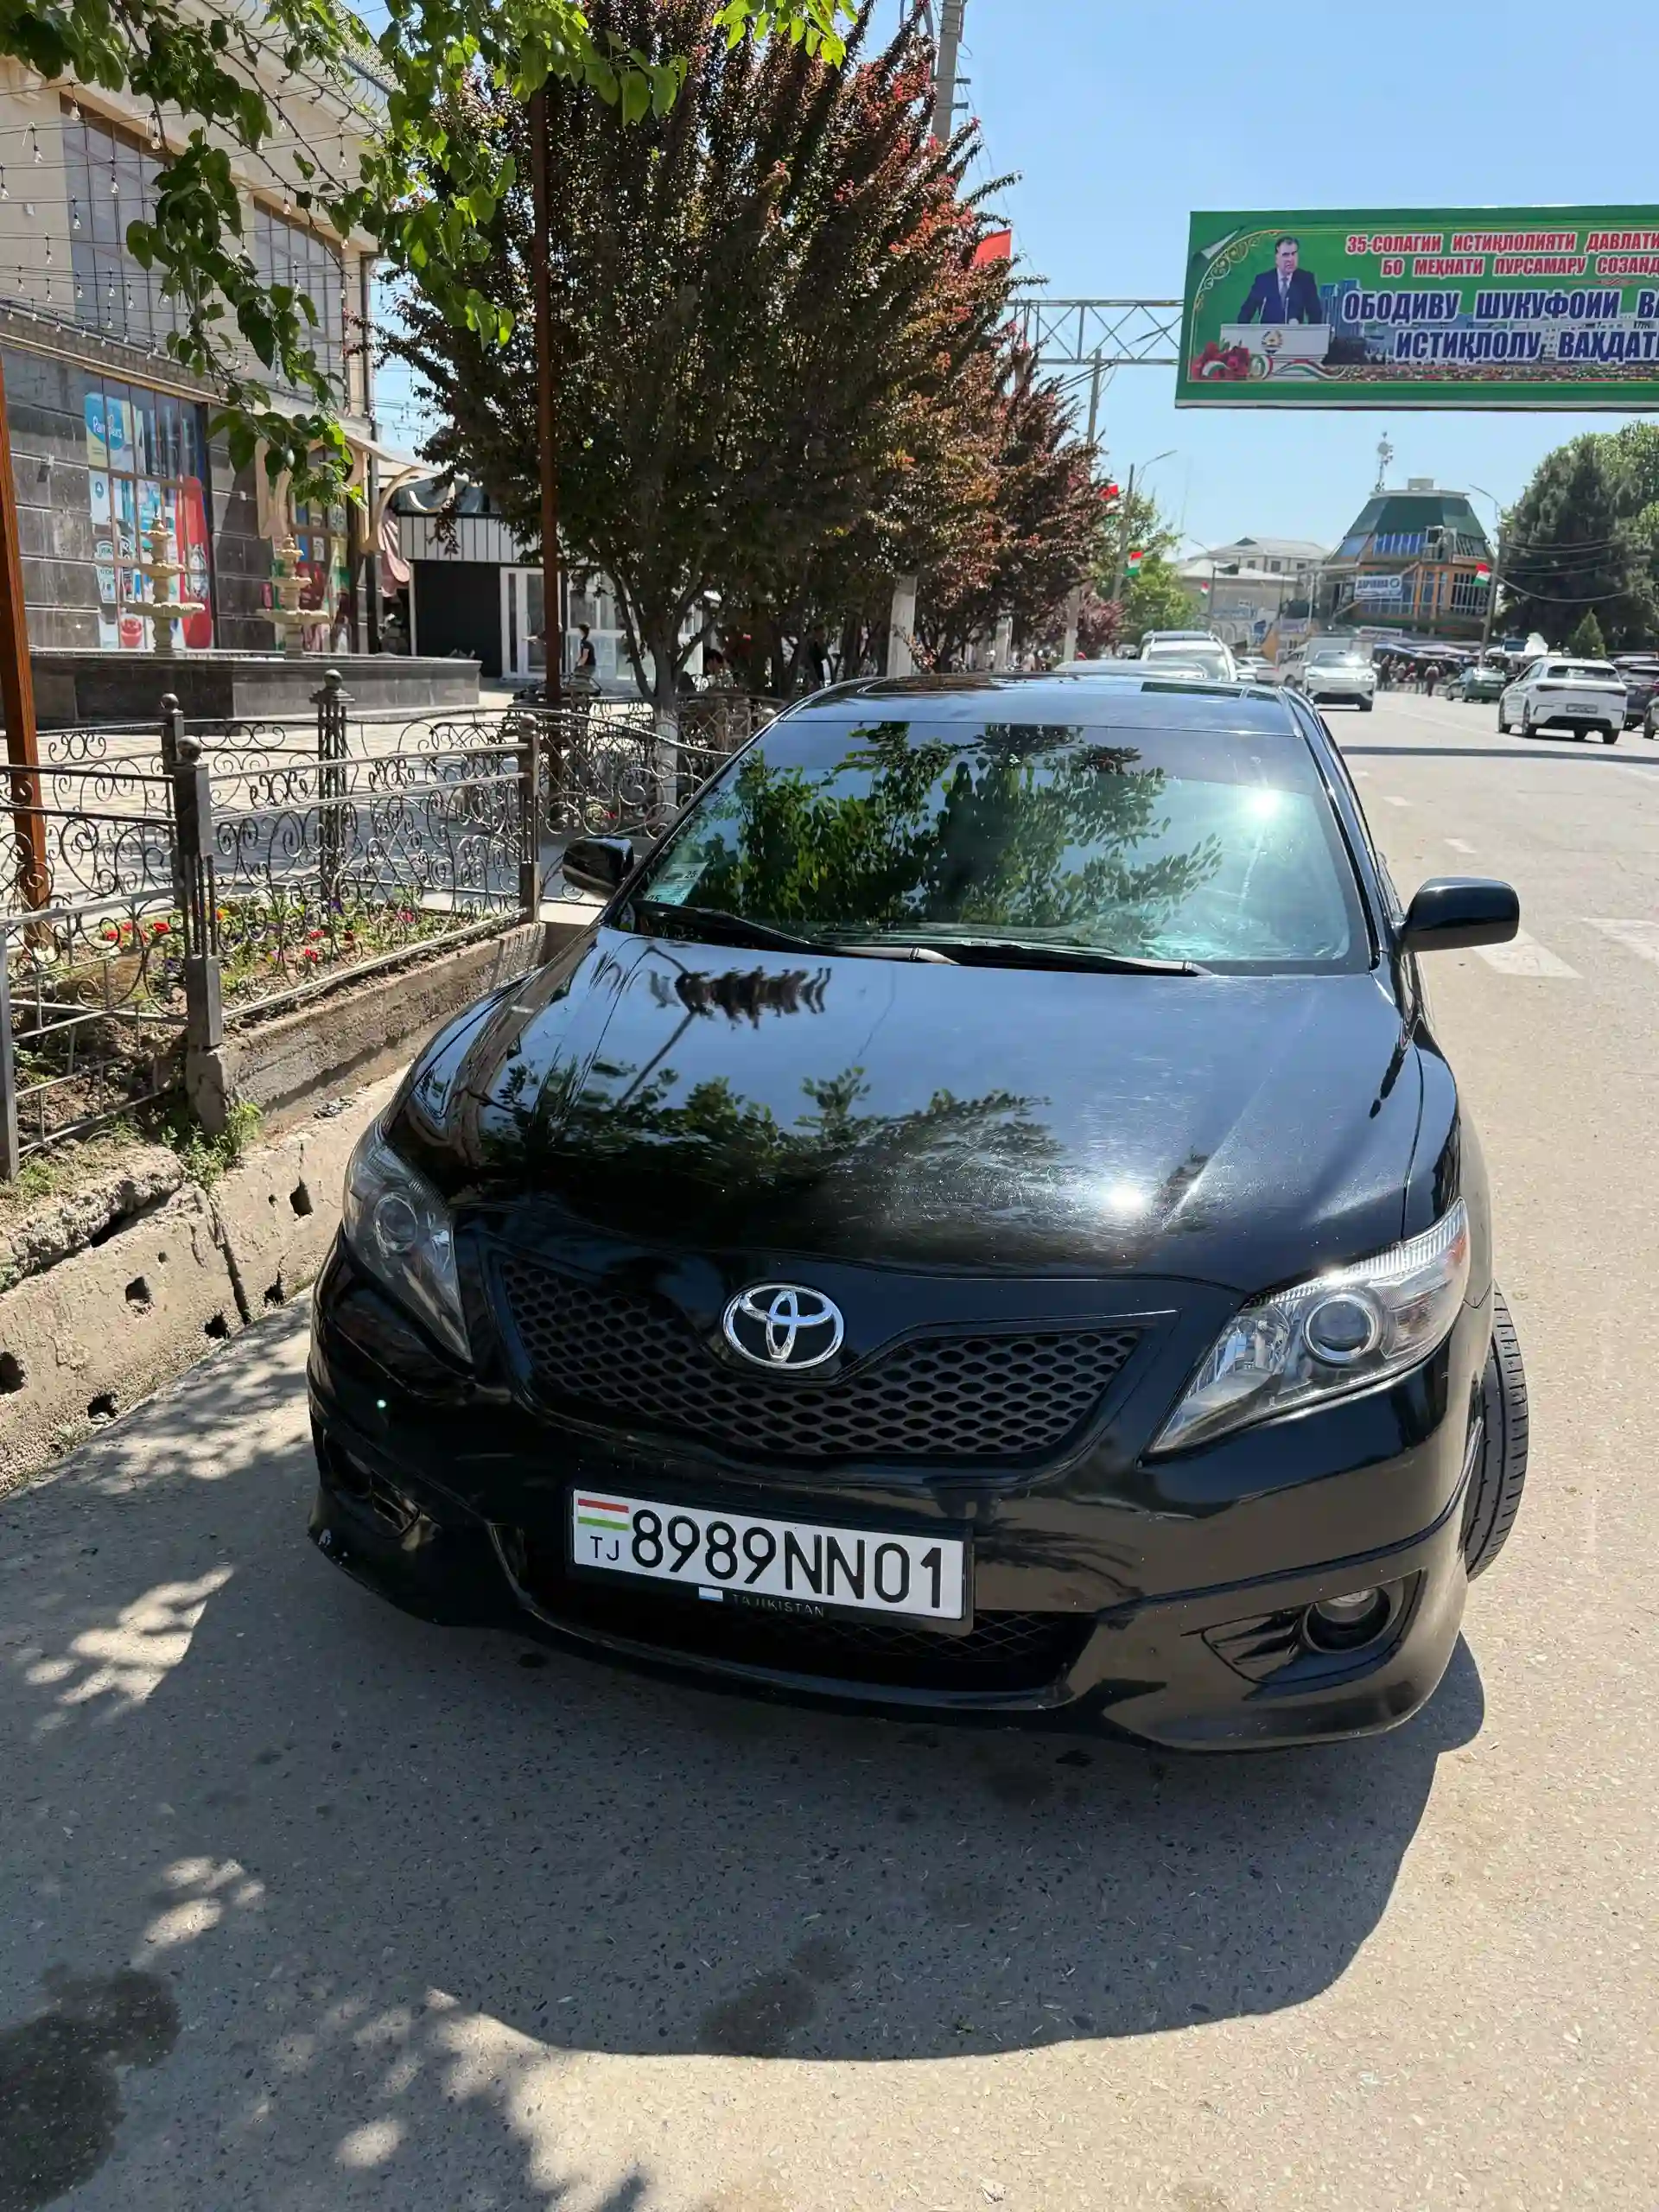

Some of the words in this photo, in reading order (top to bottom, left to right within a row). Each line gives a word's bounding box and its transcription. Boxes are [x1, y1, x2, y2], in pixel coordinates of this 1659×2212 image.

[1347, 235, 1442, 253] 35-СОЛАГИИ
[1452, 233, 1575, 254] ИСТИҚЛОЛИЯТИ
[1382, 258, 1402, 276] БО
[1414, 257, 1484, 278] МЕҲНАТИ
[1494, 257, 1586, 276] ПУРСАМАРУ
[1344, 291, 1460, 323] ОБОДИВУ
[1476, 290, 1620, 320] ШУКУФОИИ
[1637, 289, 1659, 320] В
[1395, 330, 1542, 361] ИСТИҚЛОЛУ
[589, 1535, 620, 1561] TJ
[631, 1509, 942, 1609] 8989NN01
[732, 1593, 824, 1618] TAJIKISTAN
